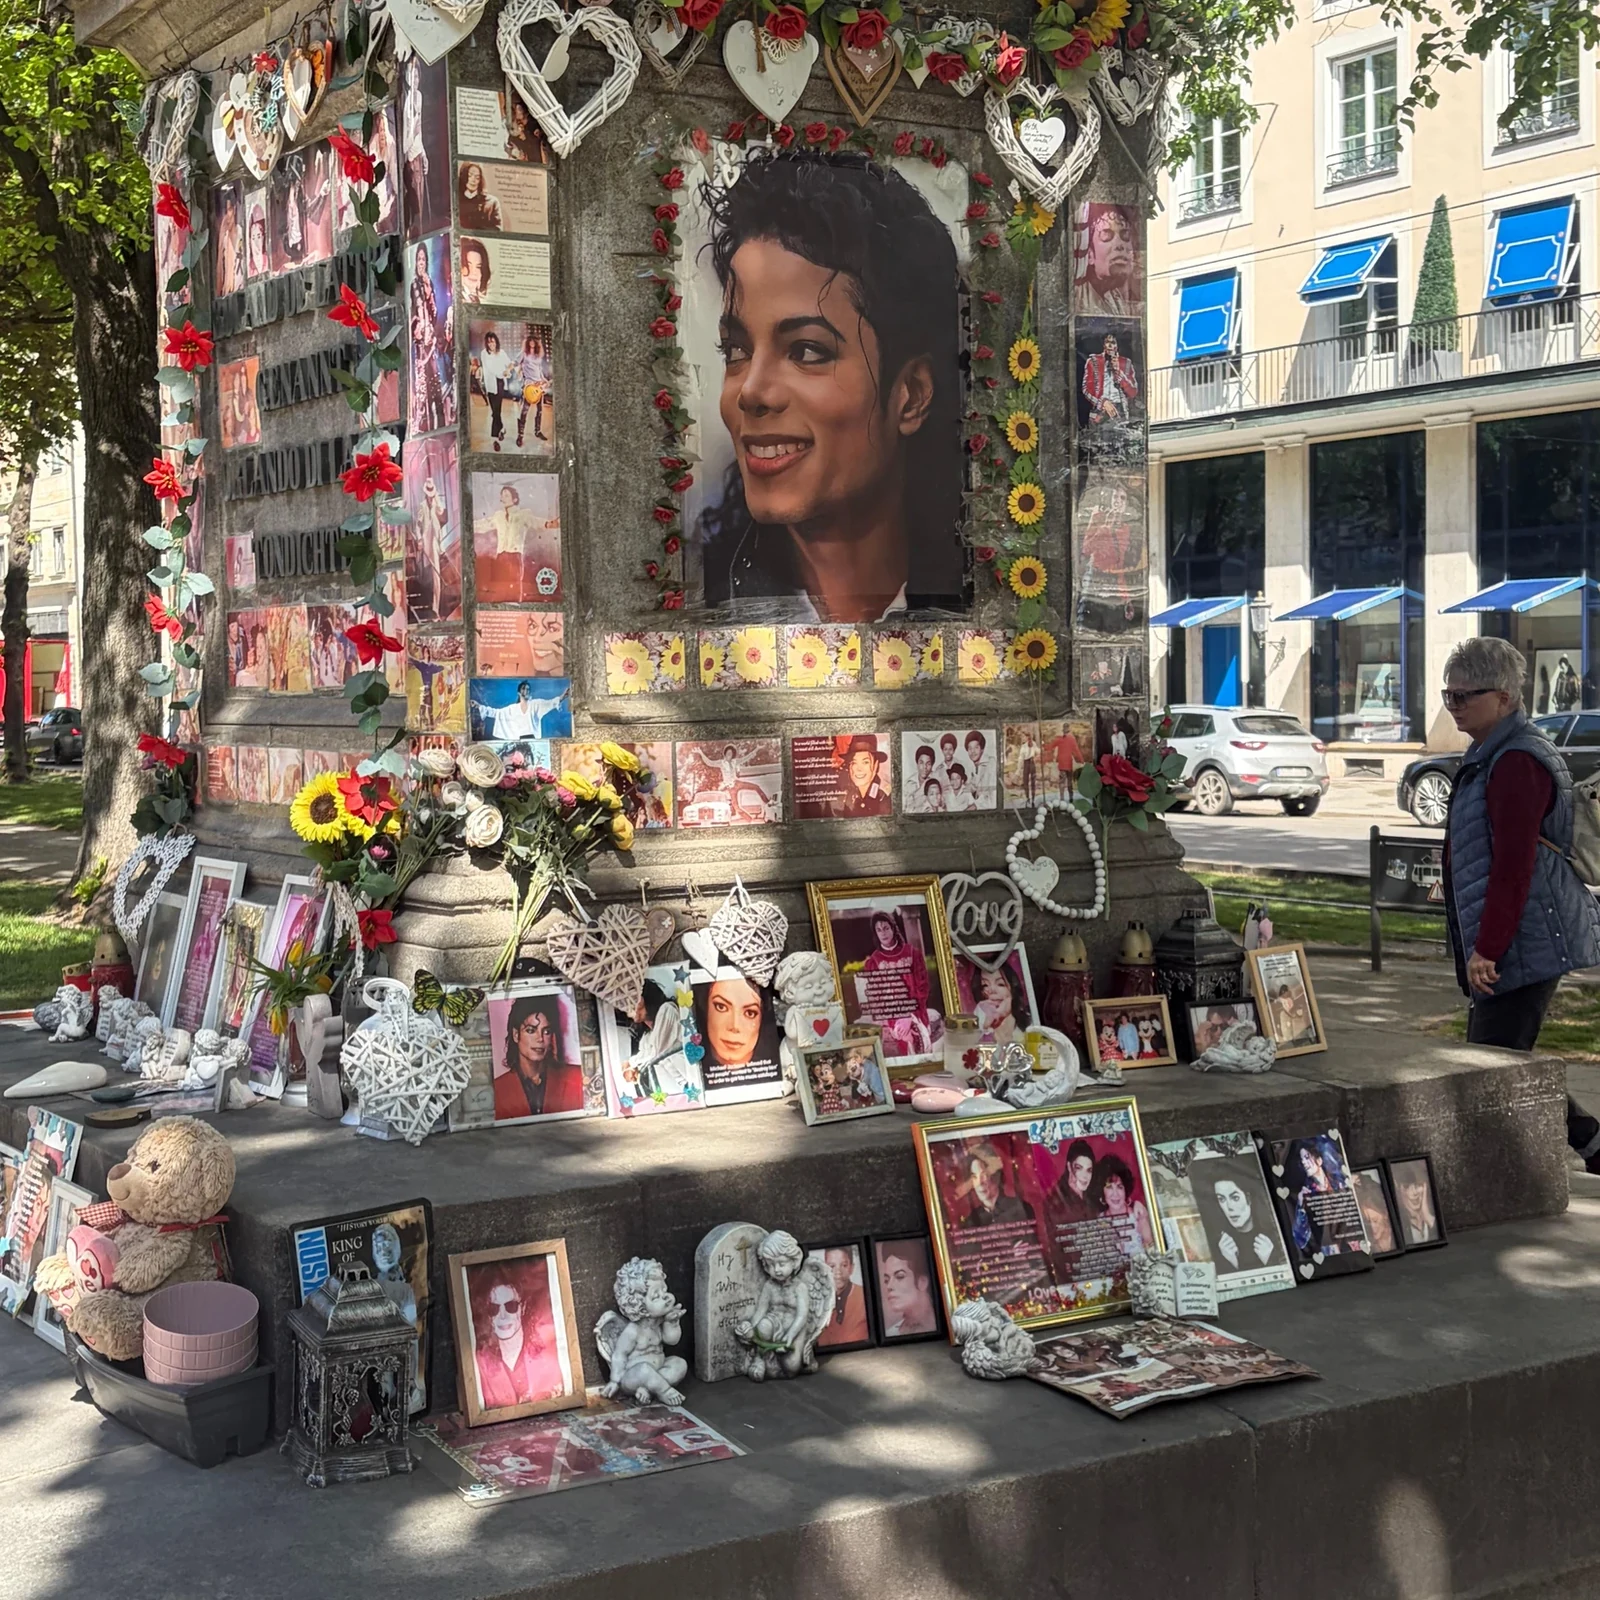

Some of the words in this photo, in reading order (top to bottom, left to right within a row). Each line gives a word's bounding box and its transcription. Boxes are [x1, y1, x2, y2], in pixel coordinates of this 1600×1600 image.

[947, 876, 1019, 937] love
[332, 1236, 363, 1254] KING
[342, 1252, 356, 1264] OF
